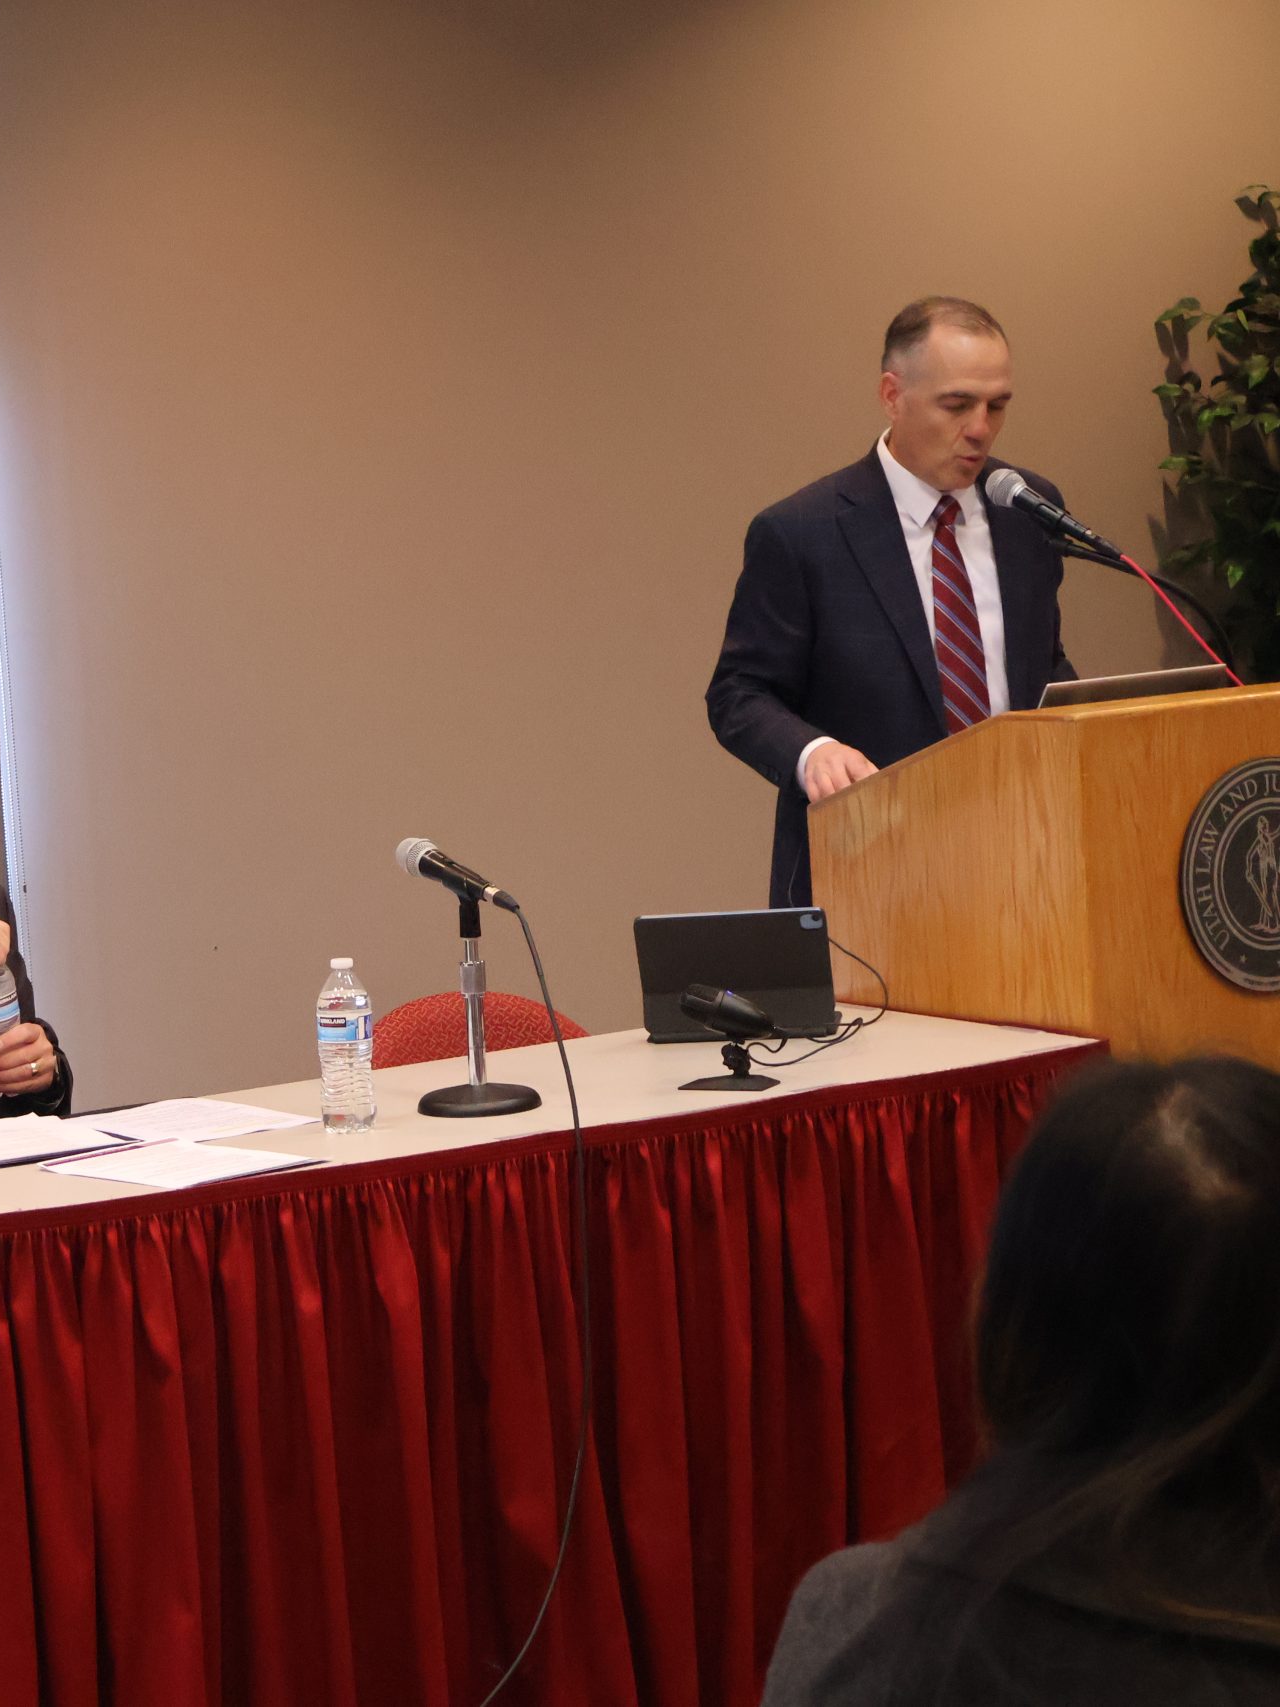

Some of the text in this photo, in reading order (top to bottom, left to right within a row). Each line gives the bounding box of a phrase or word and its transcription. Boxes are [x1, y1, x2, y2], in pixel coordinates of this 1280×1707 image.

[1220, 778, 1258, 822] AND
[1196, 825, 1219, 874] LAW
[1196, 884, 1230, 952] UTAH
